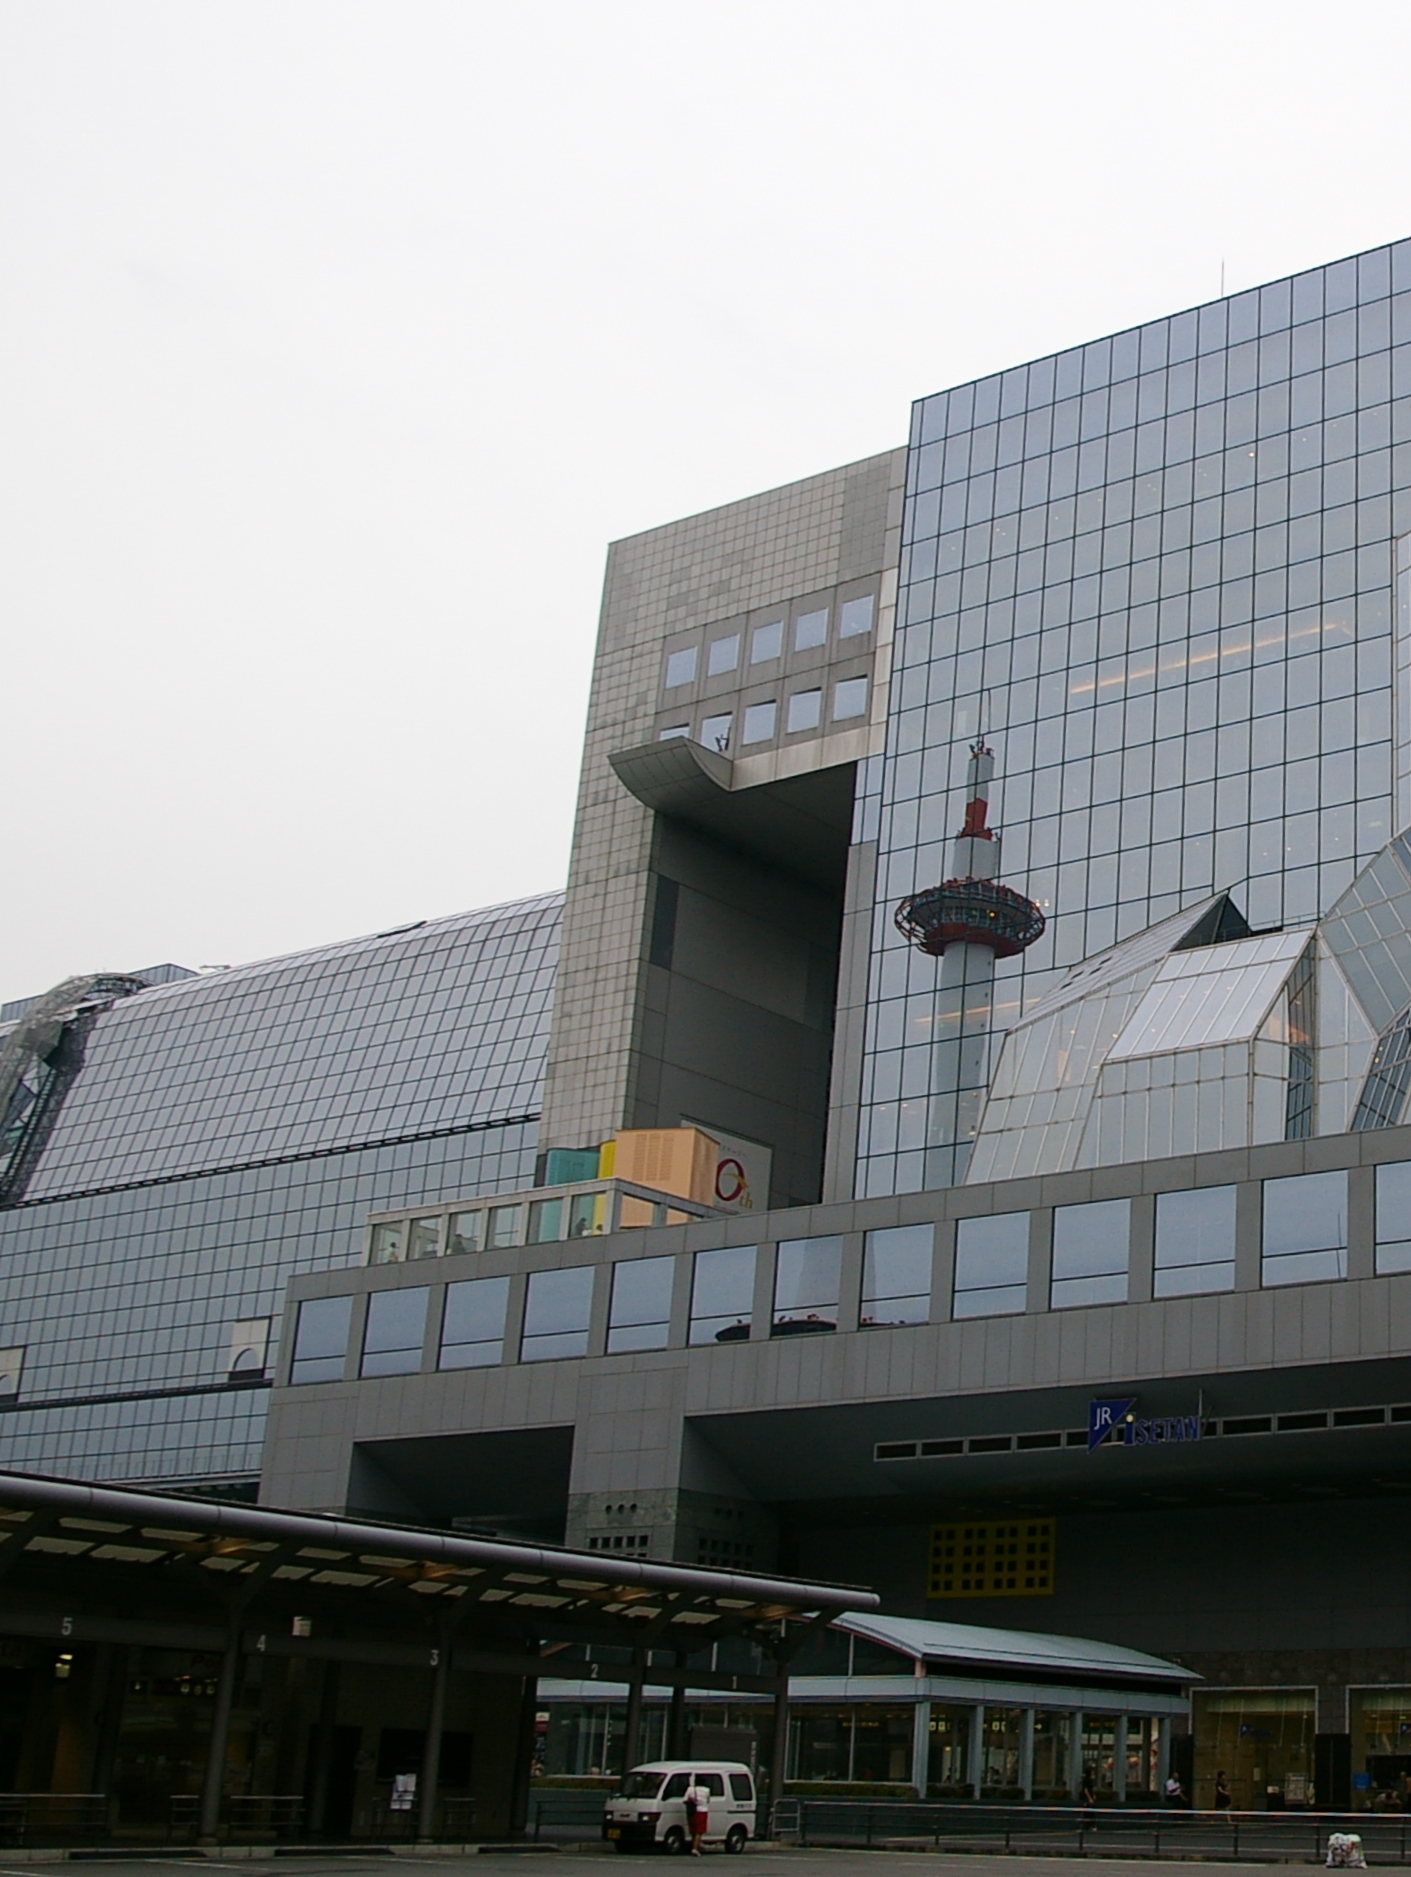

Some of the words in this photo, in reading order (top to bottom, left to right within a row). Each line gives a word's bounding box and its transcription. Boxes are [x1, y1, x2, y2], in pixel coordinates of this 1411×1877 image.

[1094, 1406, 1113, 1431] JR
[61, 1617, 74, 1636] 5
[256, 1634, 267, 1652] 4
[429, 1649, 440, 1667] 3
[590, 1663, 600, 1679] 2
[731, 1675, 739, 1690] 1
